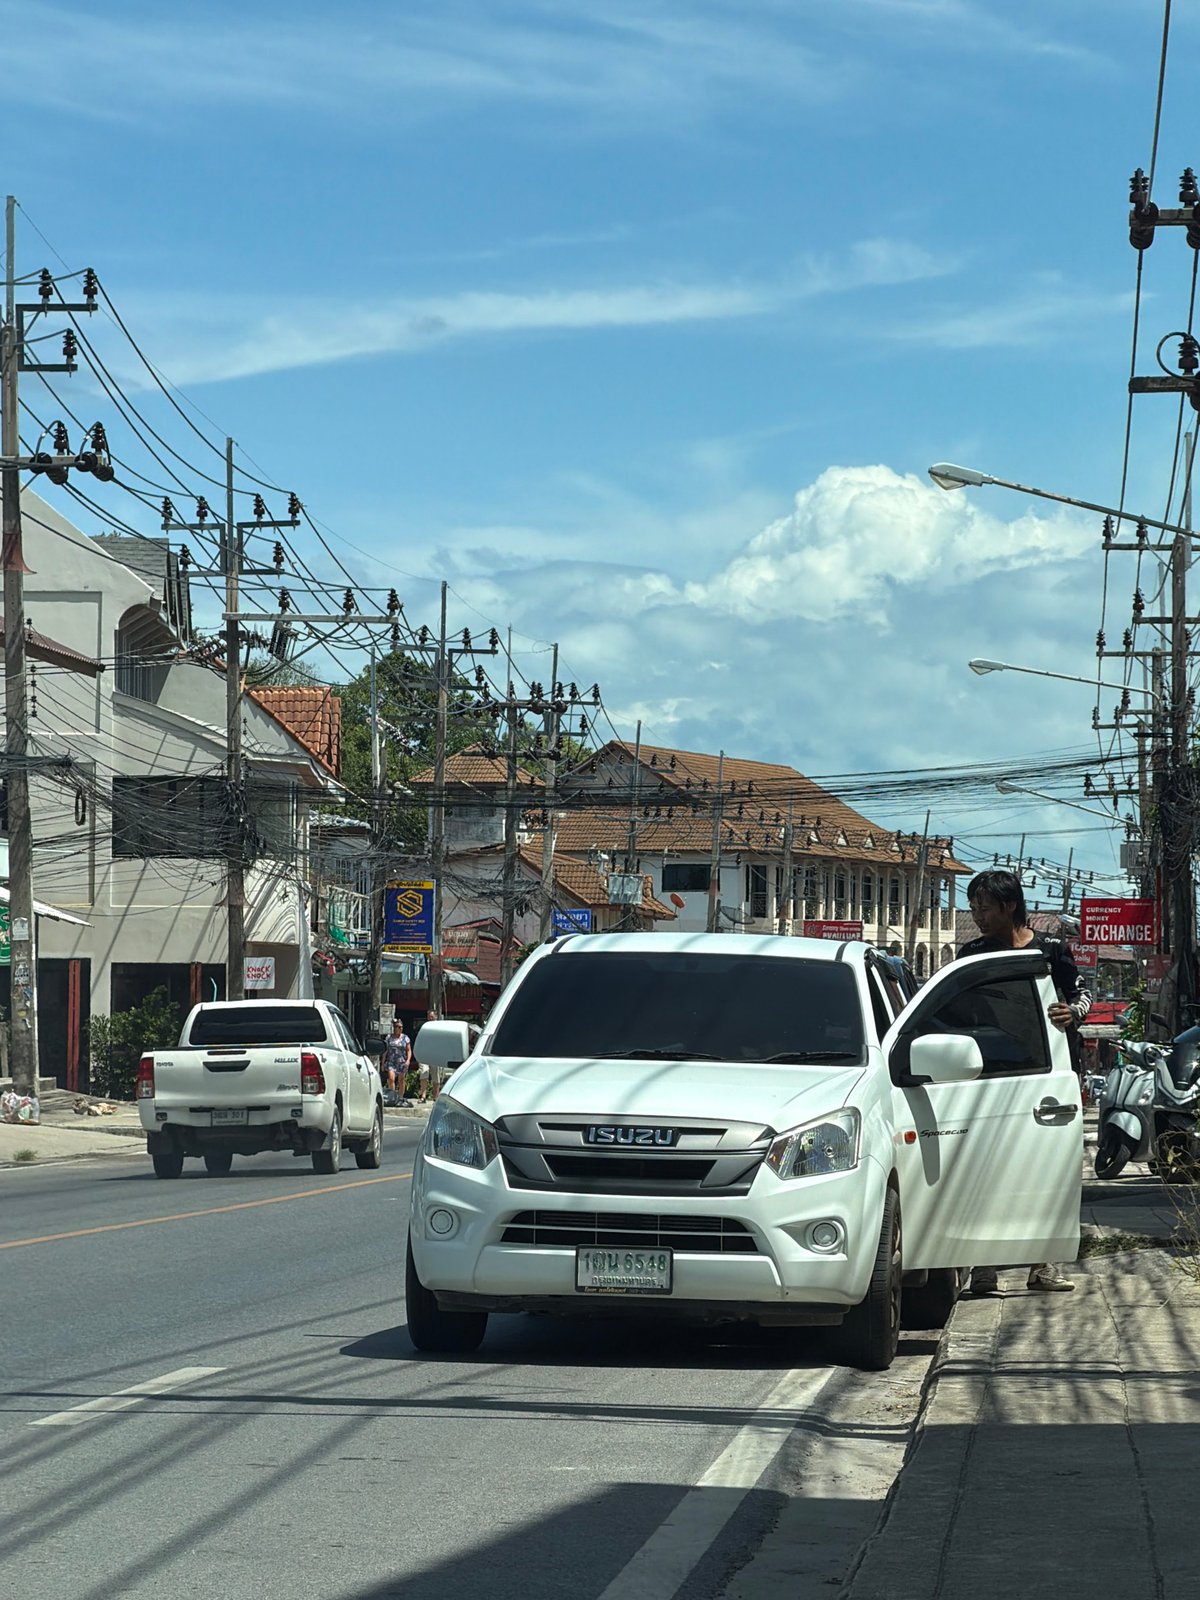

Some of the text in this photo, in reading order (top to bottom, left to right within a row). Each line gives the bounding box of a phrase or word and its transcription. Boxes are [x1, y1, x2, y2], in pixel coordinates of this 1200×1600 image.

[1085, 924, 1152, 941] EXCHANGE
[1070, 942, 1096, 953] Tops
[588, 1126, 673, 1145] ISUZU
[623, 1252, 666, 1273] 6548
